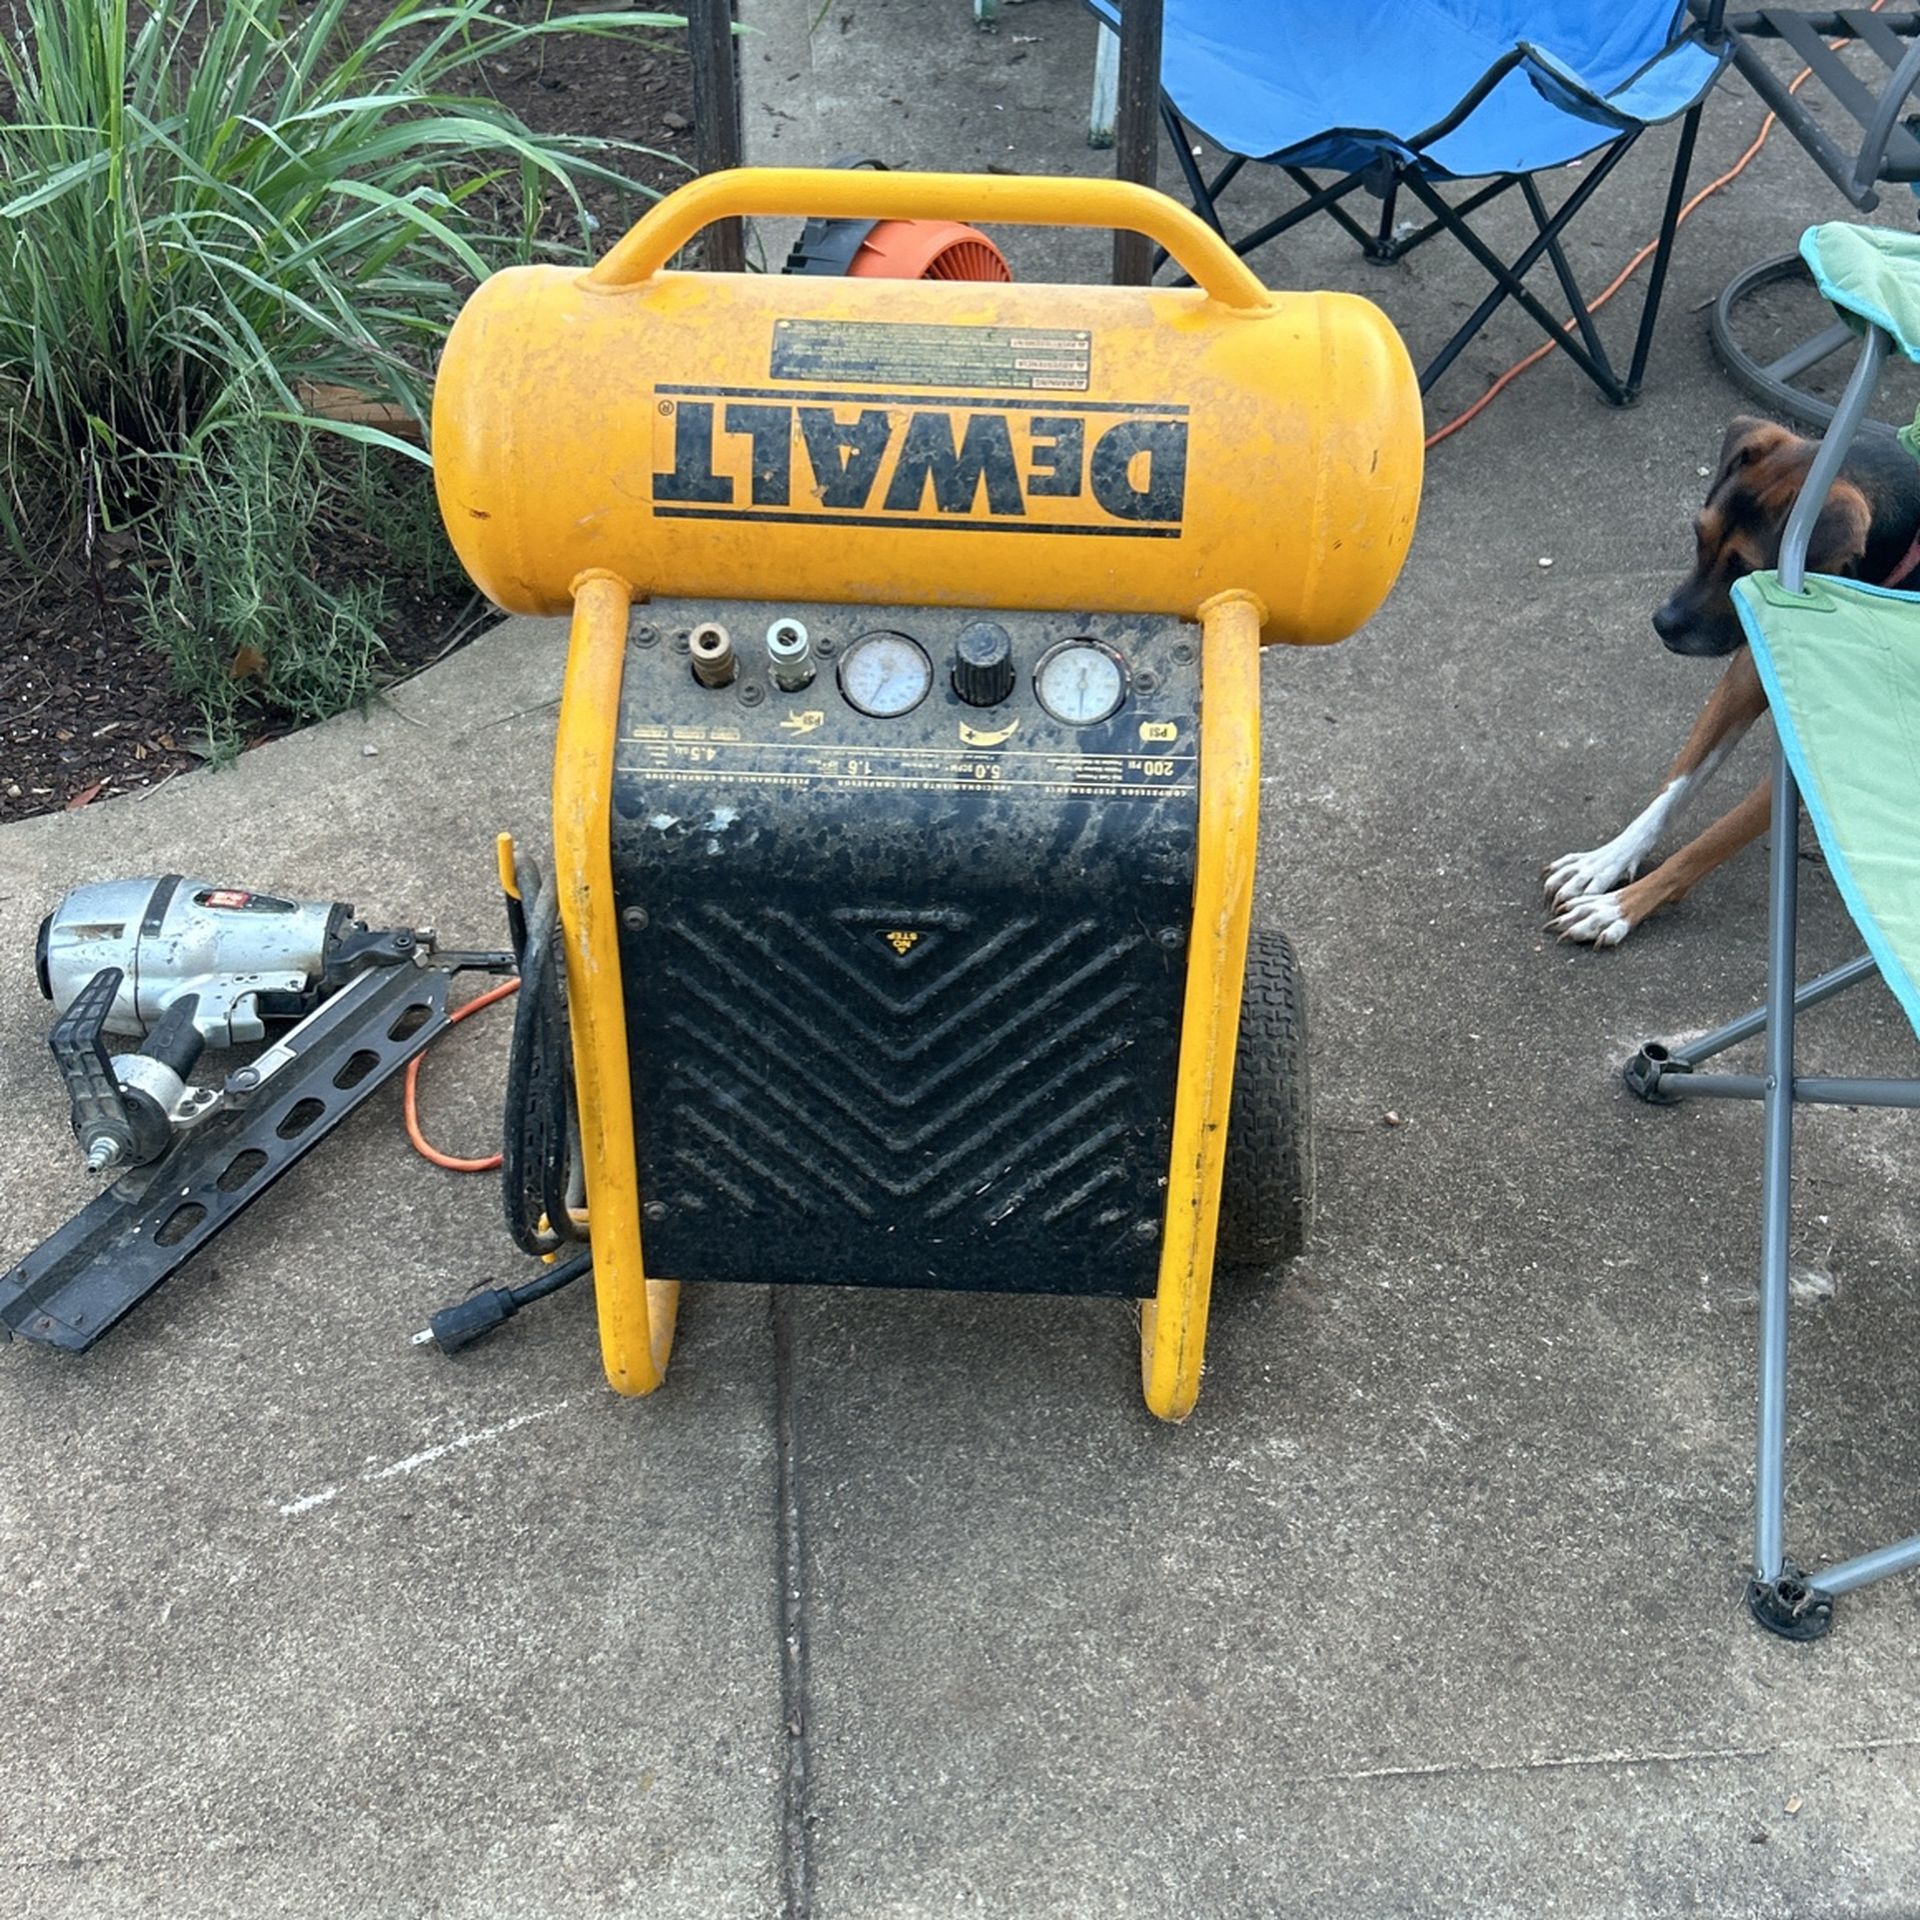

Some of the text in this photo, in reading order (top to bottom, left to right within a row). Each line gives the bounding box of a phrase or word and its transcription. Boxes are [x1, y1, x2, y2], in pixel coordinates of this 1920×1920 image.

[652, 401, 1189, 522] DEWALT
[1150, 727, 1167, 738] PSI
[690, 747, 716, 761] 4.5
[848, 760, 872, 774] 1.6
[975, 764, 1001, 778] 5.0
[1128, 761, 1142, 769] PSI
[1144, 761, 1174, 776] 200
[1044, 787, 1187, 797] COMPRESSOR PERFORMANCE
[886, 932, 918, 940] STEP
[893, 940, 911, 948] NO
